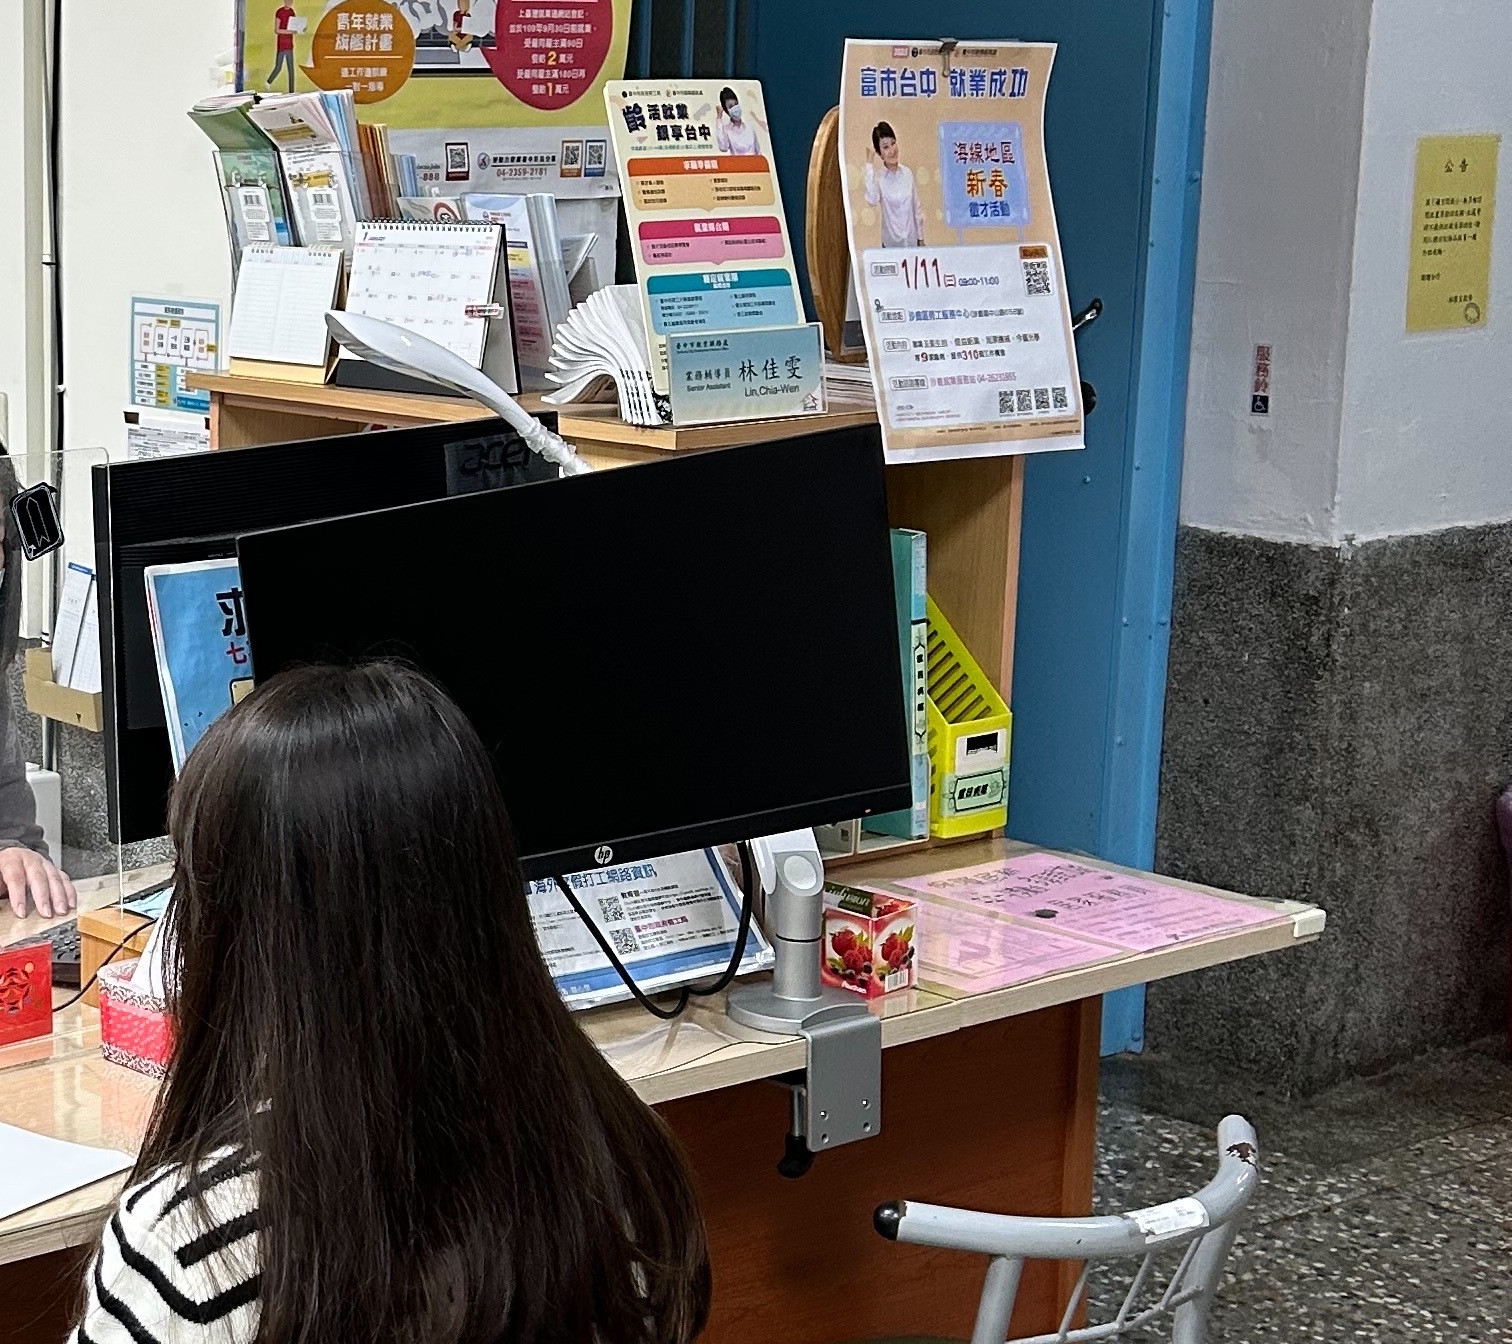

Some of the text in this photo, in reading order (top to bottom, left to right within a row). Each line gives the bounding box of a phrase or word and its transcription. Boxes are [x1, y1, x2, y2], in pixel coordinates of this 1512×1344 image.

[861, 67, 1029, 98] 富市台中 就業成功
[954, 142, 1015, 164] 海線地區
[967, 169, 1008, 197] 新春
[738, 355, 803, 382] 林佳雯
[596, 846, 612, 864] hp
[525, 863, 658, 895] 海外假打工網路資訊
